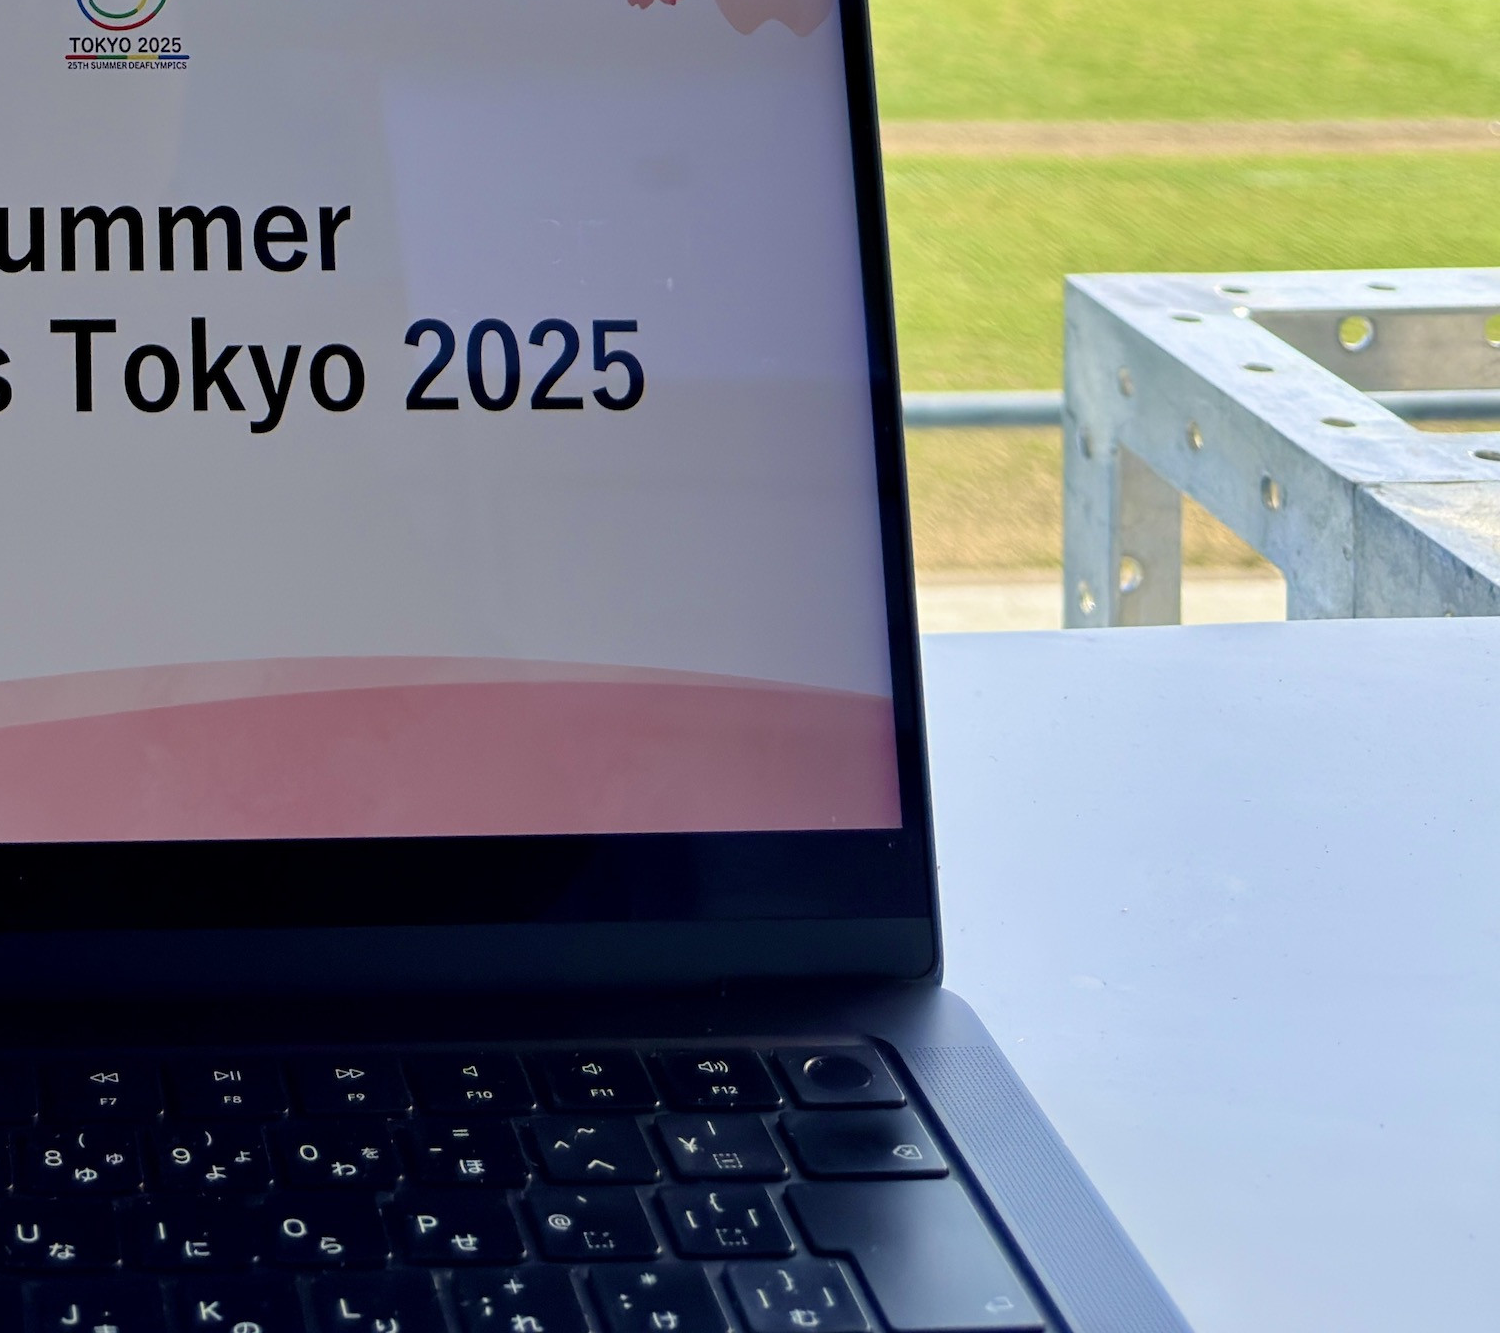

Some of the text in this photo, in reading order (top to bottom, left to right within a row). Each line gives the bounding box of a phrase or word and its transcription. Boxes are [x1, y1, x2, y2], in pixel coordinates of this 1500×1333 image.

[68, 36, 183, 54] TOKYO 2025
[66, 60, 188, 71] 25TH SUMMER DEAFLYMPICS
[48, 315, 366, 435] Tokyo
[403, 317, 646, 413] 2025
[346, 1092, 367, 1102] F9
[465, 1090, 494, 1100] F10
[589, 1088, 615, 1097] F11
[710, 1085, 740, 1095] F12
[98, 1097, 118, 1106] F7
[222, 1095, 244, 1104] F8
[43, 1149, 64, 1167] 8
[171, 1147, 192, 1165] 9
[15, 1223, 40, 1243] U
[416, 1215, 439, 1234] P
[60, 1304, 80, 1325] J
[198, 1300, 223, 1321] K
[338, 1298, 362, 1319] L
